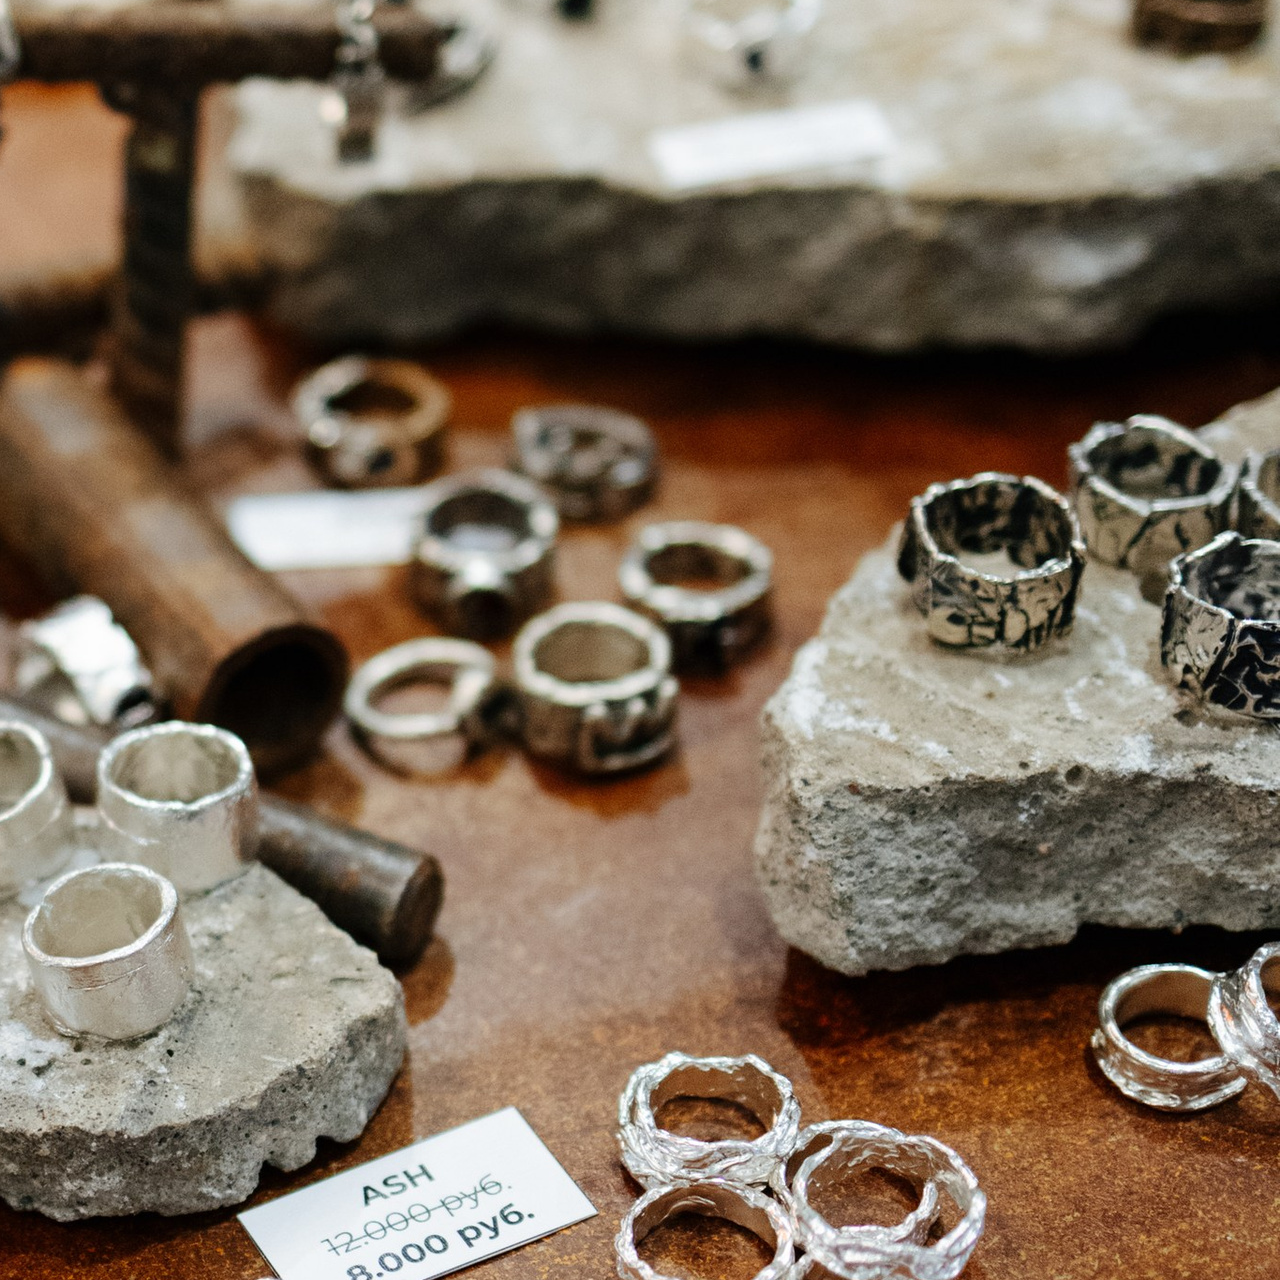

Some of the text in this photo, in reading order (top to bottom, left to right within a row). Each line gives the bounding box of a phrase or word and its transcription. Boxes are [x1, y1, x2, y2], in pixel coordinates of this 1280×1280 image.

[362, 1164, 436, 1207] ASH
[320, 1173, 513, 1257] 12.000 руб.
[457, 1202, 535, 1248] руб.
